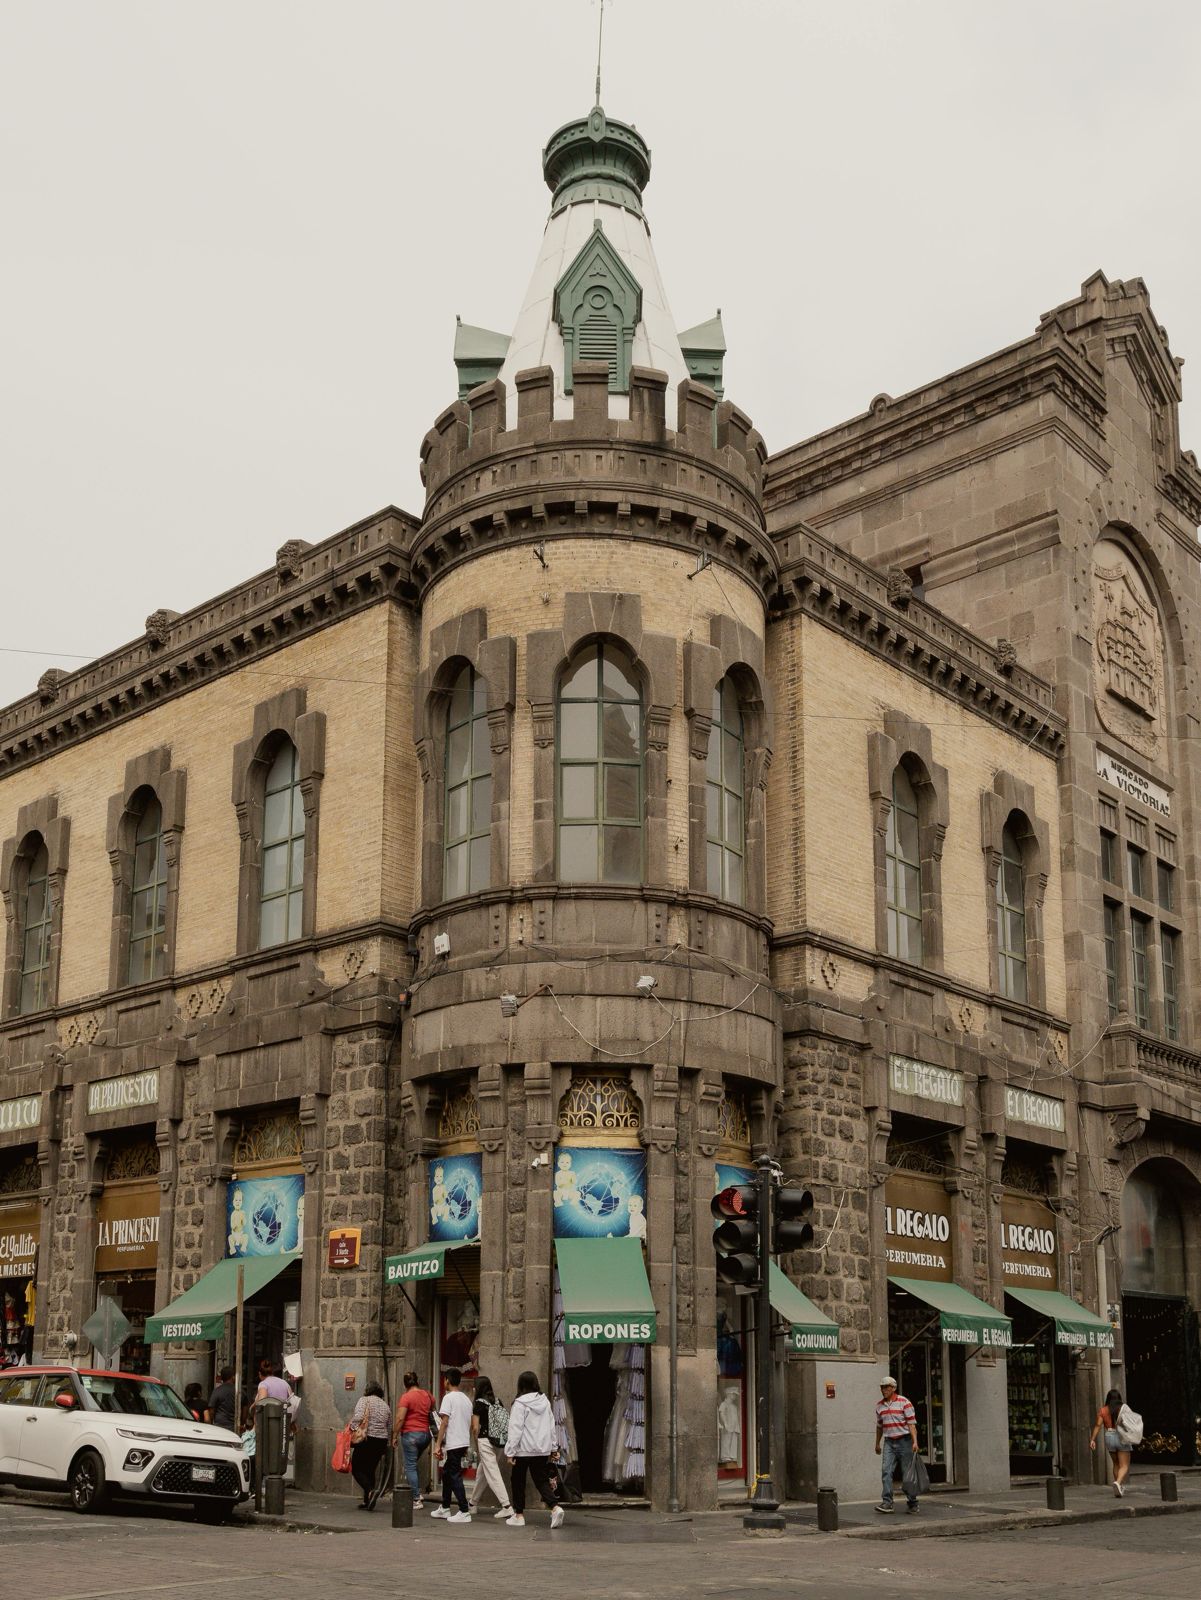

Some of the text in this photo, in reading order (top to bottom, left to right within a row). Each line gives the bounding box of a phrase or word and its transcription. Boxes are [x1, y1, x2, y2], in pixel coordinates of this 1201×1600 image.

[1111, 760, 1149, 790] MERCADO
[89, 1073, 158, 1111] LA PRINCESITA
[912, 1064, 959, 1101] REGALO
[1006, 1090, 1061, 1128] EL REGALO
[99, 1222, 111, 1246] LA
[896, 1208, 950, 1242] REGALO
[1008, 1224, 1055, 1255] REGALO
[388, 1259, 440, 1280] BAUTIZO
[162, 1322, 202, 1337] VESTIDOS
[568, 1323, 651, 1340] ROPONES
[795, 1333, 838, 1350] COMUNION
[942, 1328, 1012, 1347] PERFUMERIA EL REGALO
[1058, 1331, 1088, 1346] PERFUMERIA
[1089, 1331, 1096, 1347] EL
